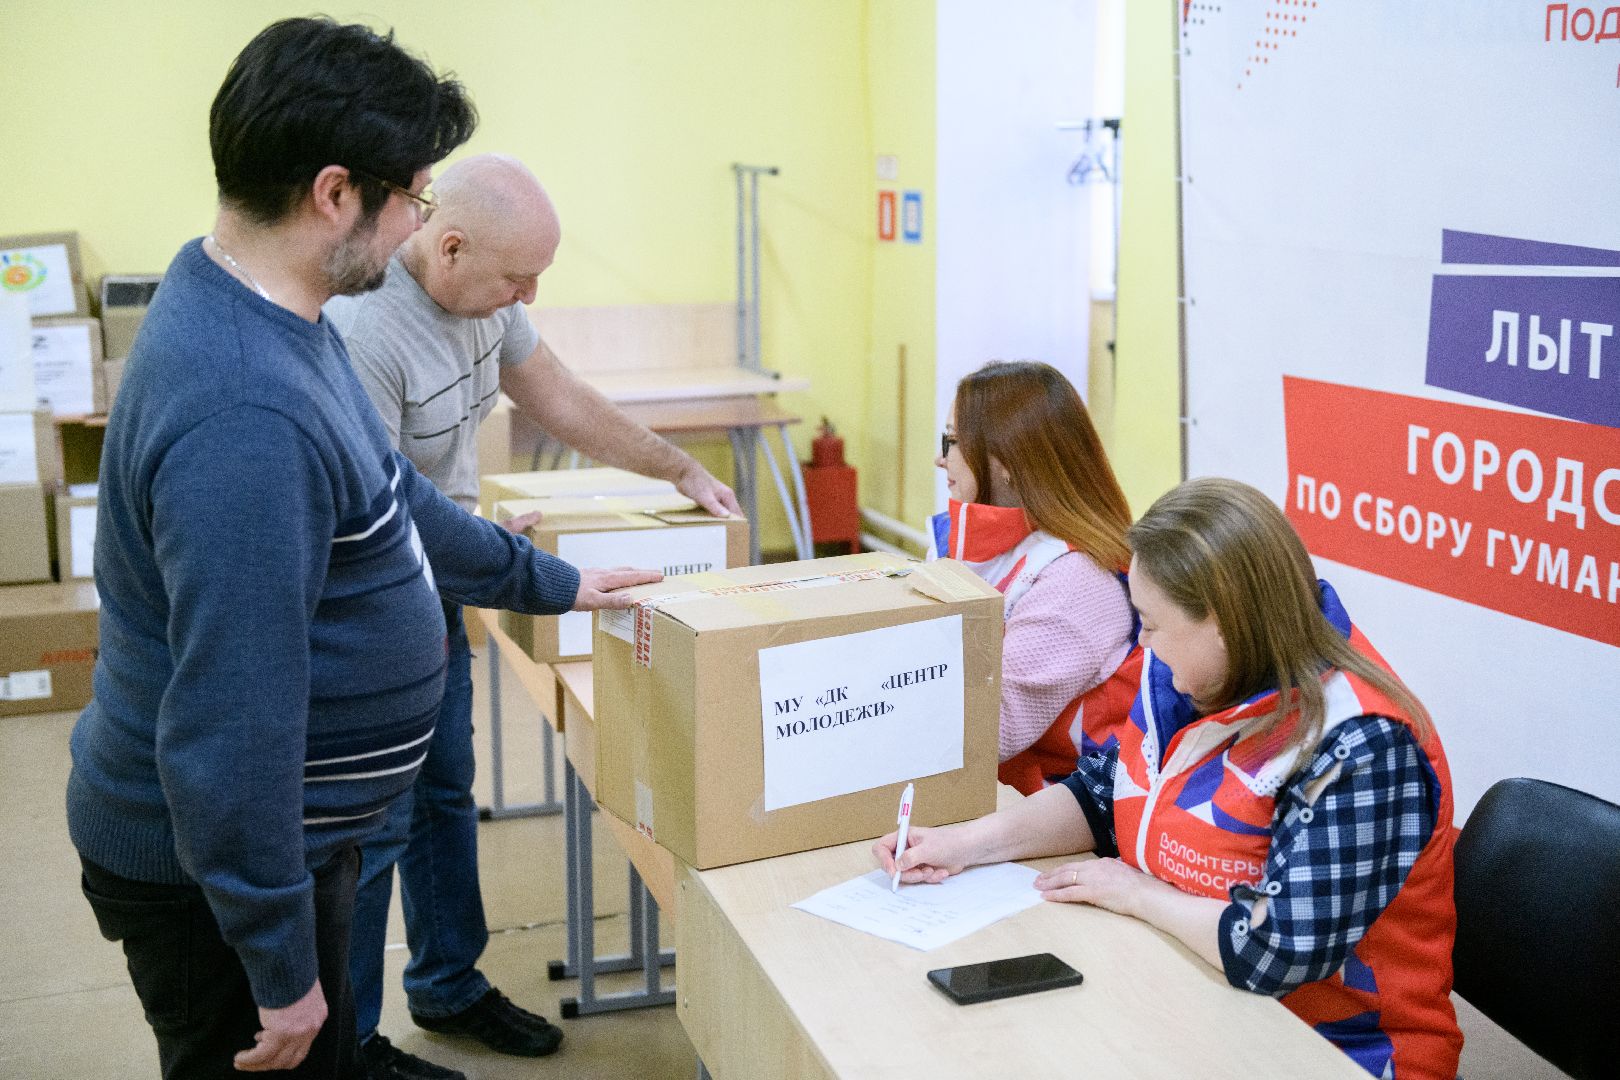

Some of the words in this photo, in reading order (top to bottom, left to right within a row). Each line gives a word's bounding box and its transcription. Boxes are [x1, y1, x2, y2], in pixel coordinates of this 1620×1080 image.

[1485, 309, 1613, 379] ЛЫТ
[1407, 423, 1620, 530] ГОРОДС
[1297, 474, 1341, 520] ПО
[1353, 492, 1472, 558] СБОРУ
[774, 696, 803, 716] МУ
[815, 686, 849, 708] «ДК
[881, 663, 948, 691] «ЦЕНТР
[776, 700, 895, 740] МОЛОДЕЖИ»
